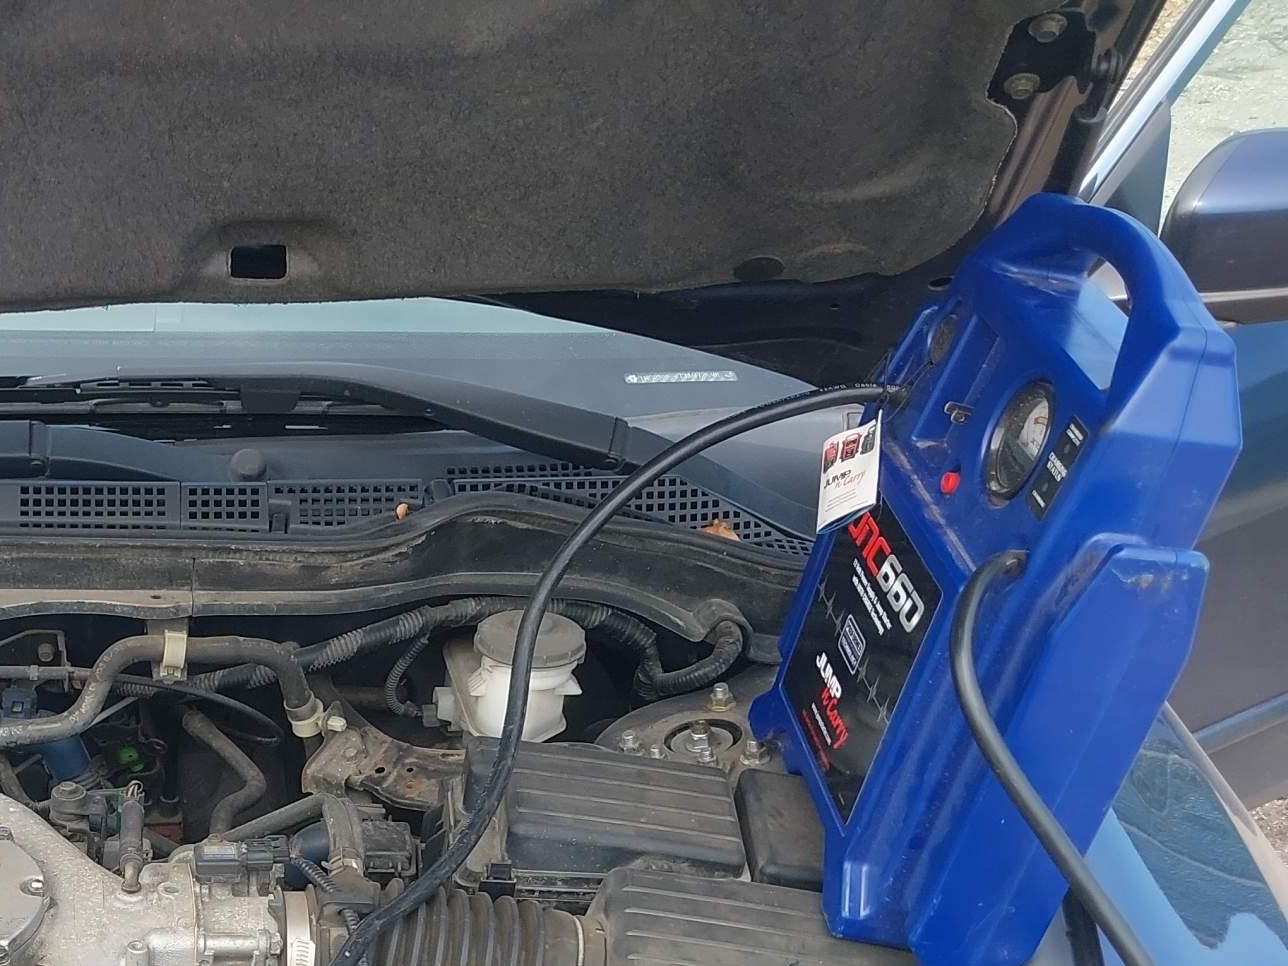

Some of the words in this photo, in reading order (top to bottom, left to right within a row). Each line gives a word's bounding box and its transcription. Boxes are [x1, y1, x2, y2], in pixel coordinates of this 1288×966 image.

[824, 469, 852, 488] JUMP
[848, 512, 925, 632] JNC660
[816, 652, 842, 699] JUMP
[826, 698, 848, 749] Carry
